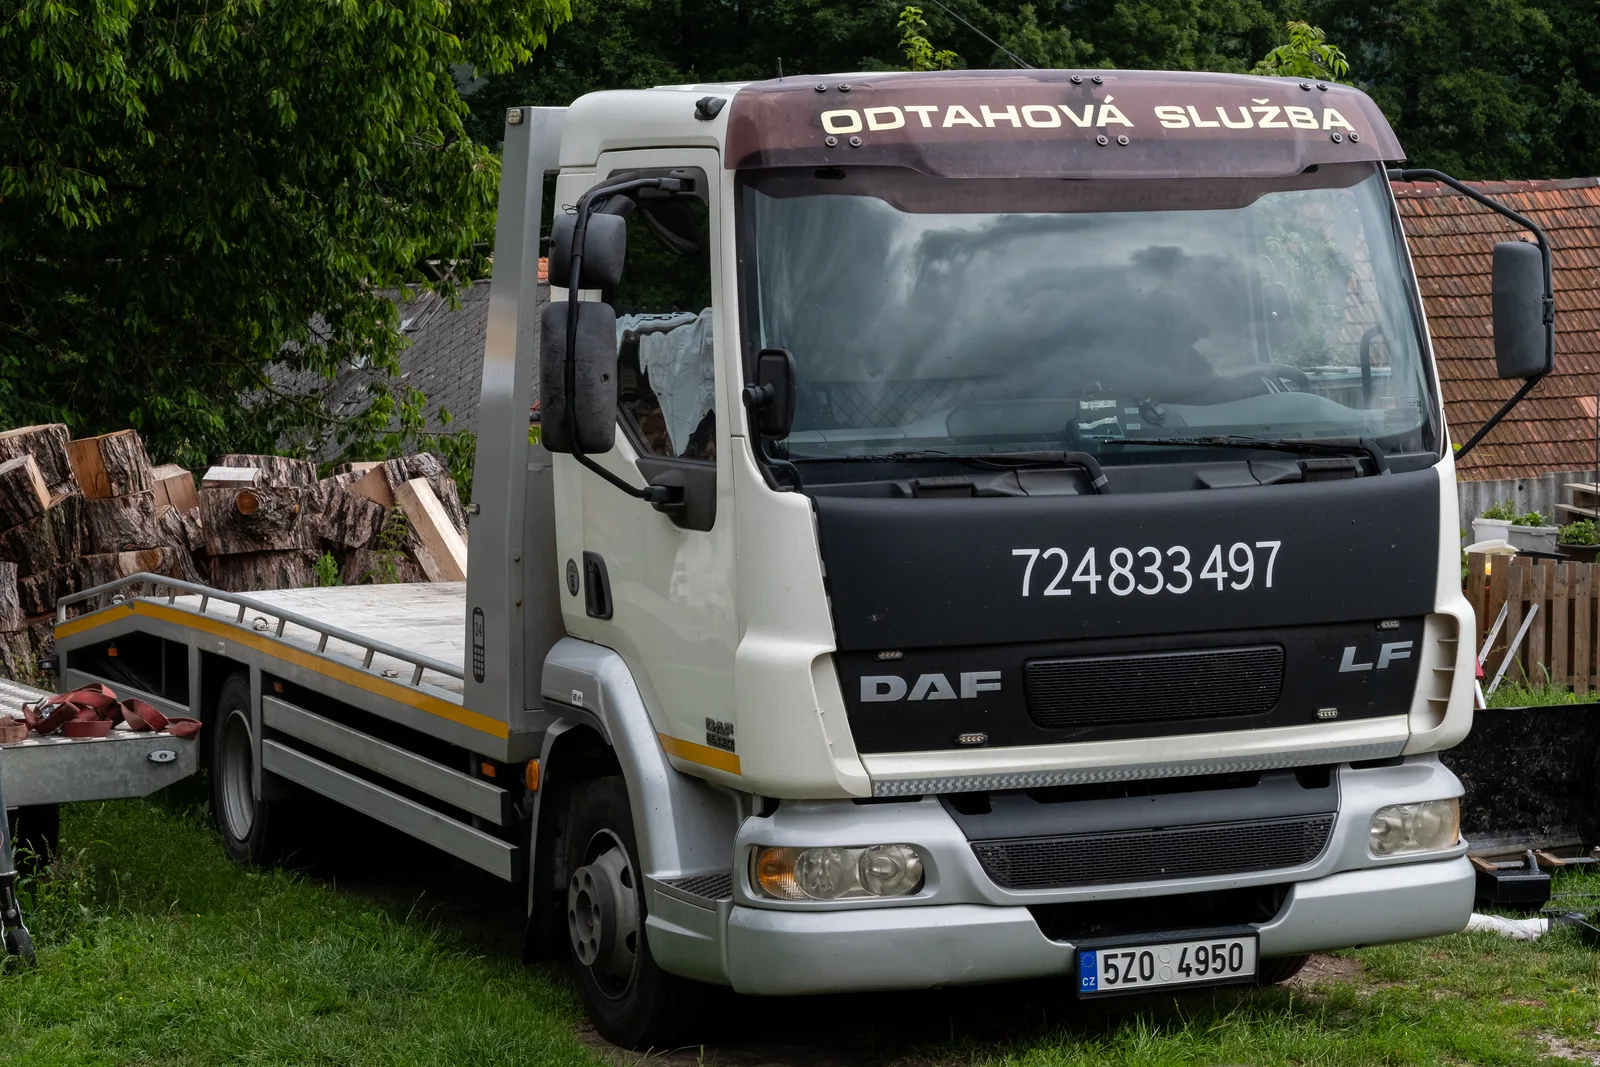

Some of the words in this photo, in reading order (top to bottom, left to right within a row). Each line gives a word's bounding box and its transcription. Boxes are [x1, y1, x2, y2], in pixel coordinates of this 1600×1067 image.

[821, 95, 1134, 135] ODTAHOVÁ
[1154, 97, 1357, 131] SLUŽBA
[1338, 640, 1414, 673] LF
[860, 671, 1002, 702] DAF
[705, 717, 733, 736] DAF
[1103, 950, 1154, 985] 5Z0
[1177, 942, 1244, 978] 4950
[1082, 976, 1096, 987] CZ
